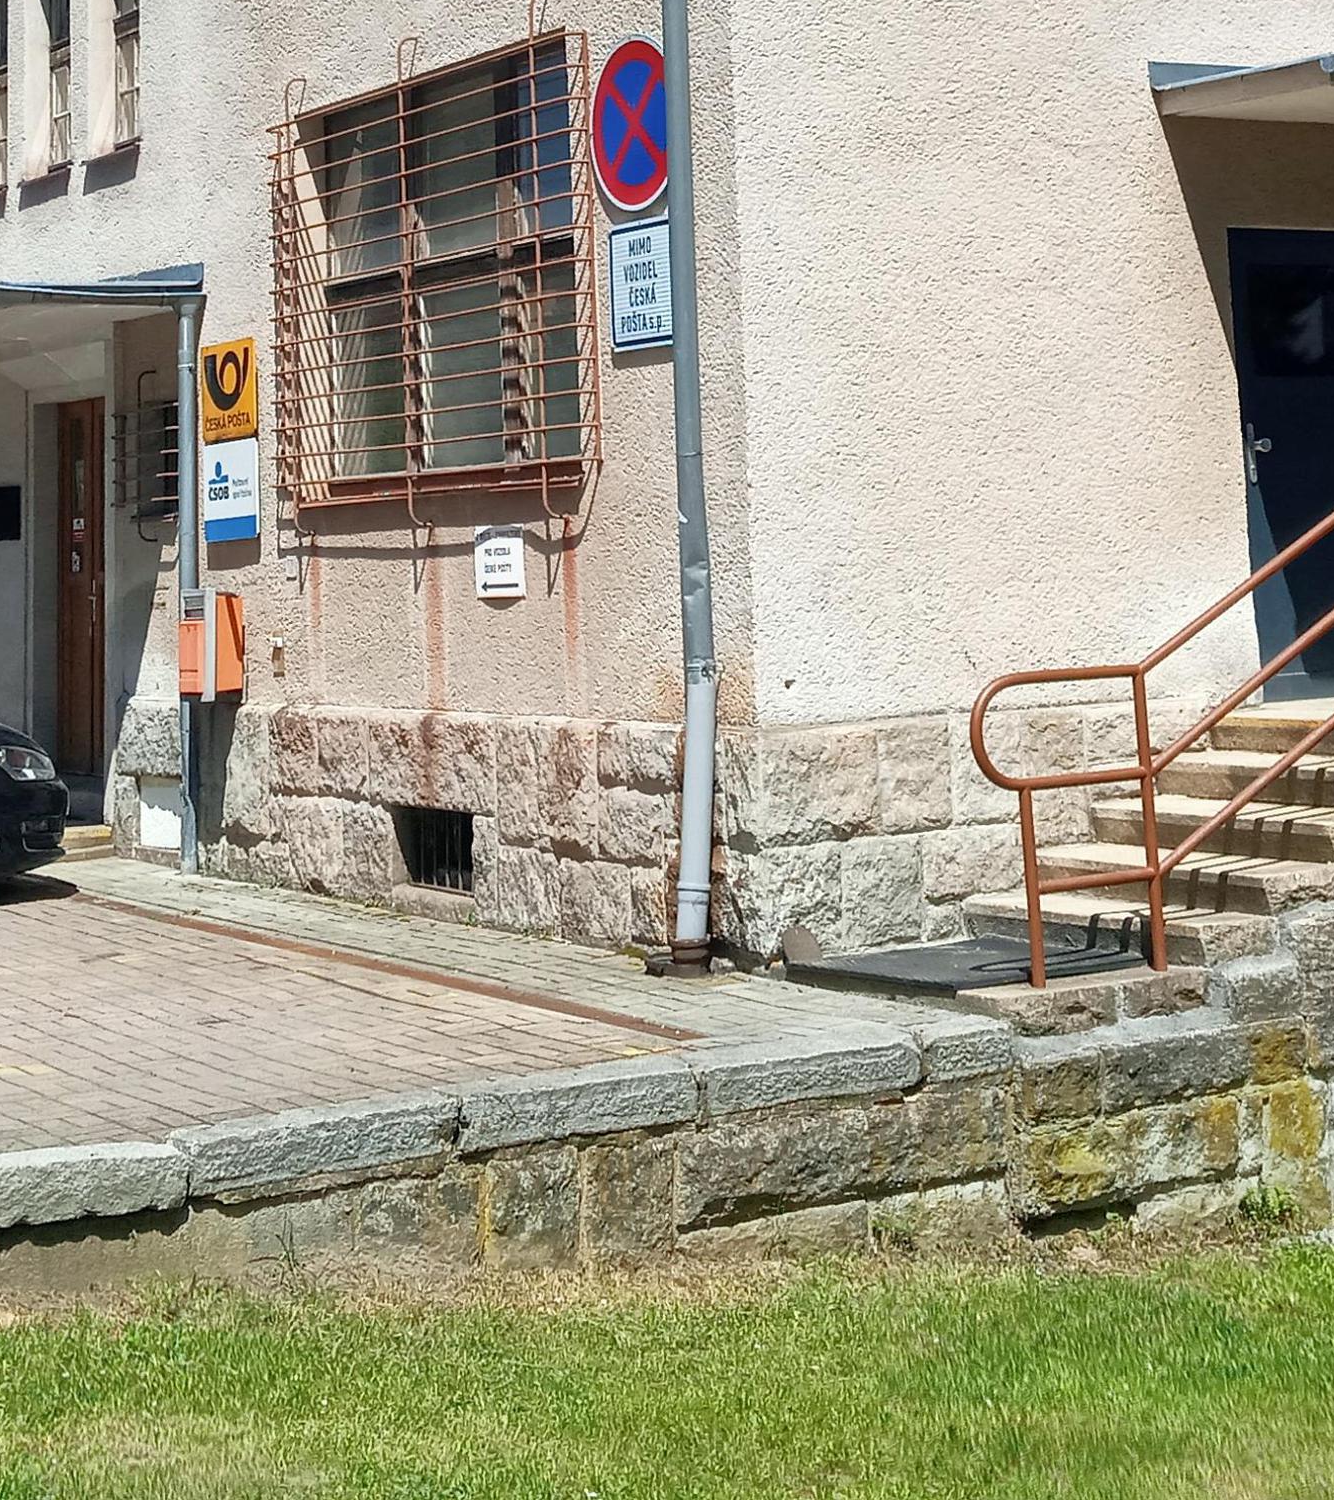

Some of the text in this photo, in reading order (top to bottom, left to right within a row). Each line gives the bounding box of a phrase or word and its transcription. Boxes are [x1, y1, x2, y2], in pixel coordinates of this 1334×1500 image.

[628, 236, 652, 257] MIMO
[623, 260, 658, 283] VOZIDEL
[628, 282, 657, 307] ČESKÁ
[621, 311, 666, 334] POŠTA s.p.
[227, 410, 251, 428] POŠTA
